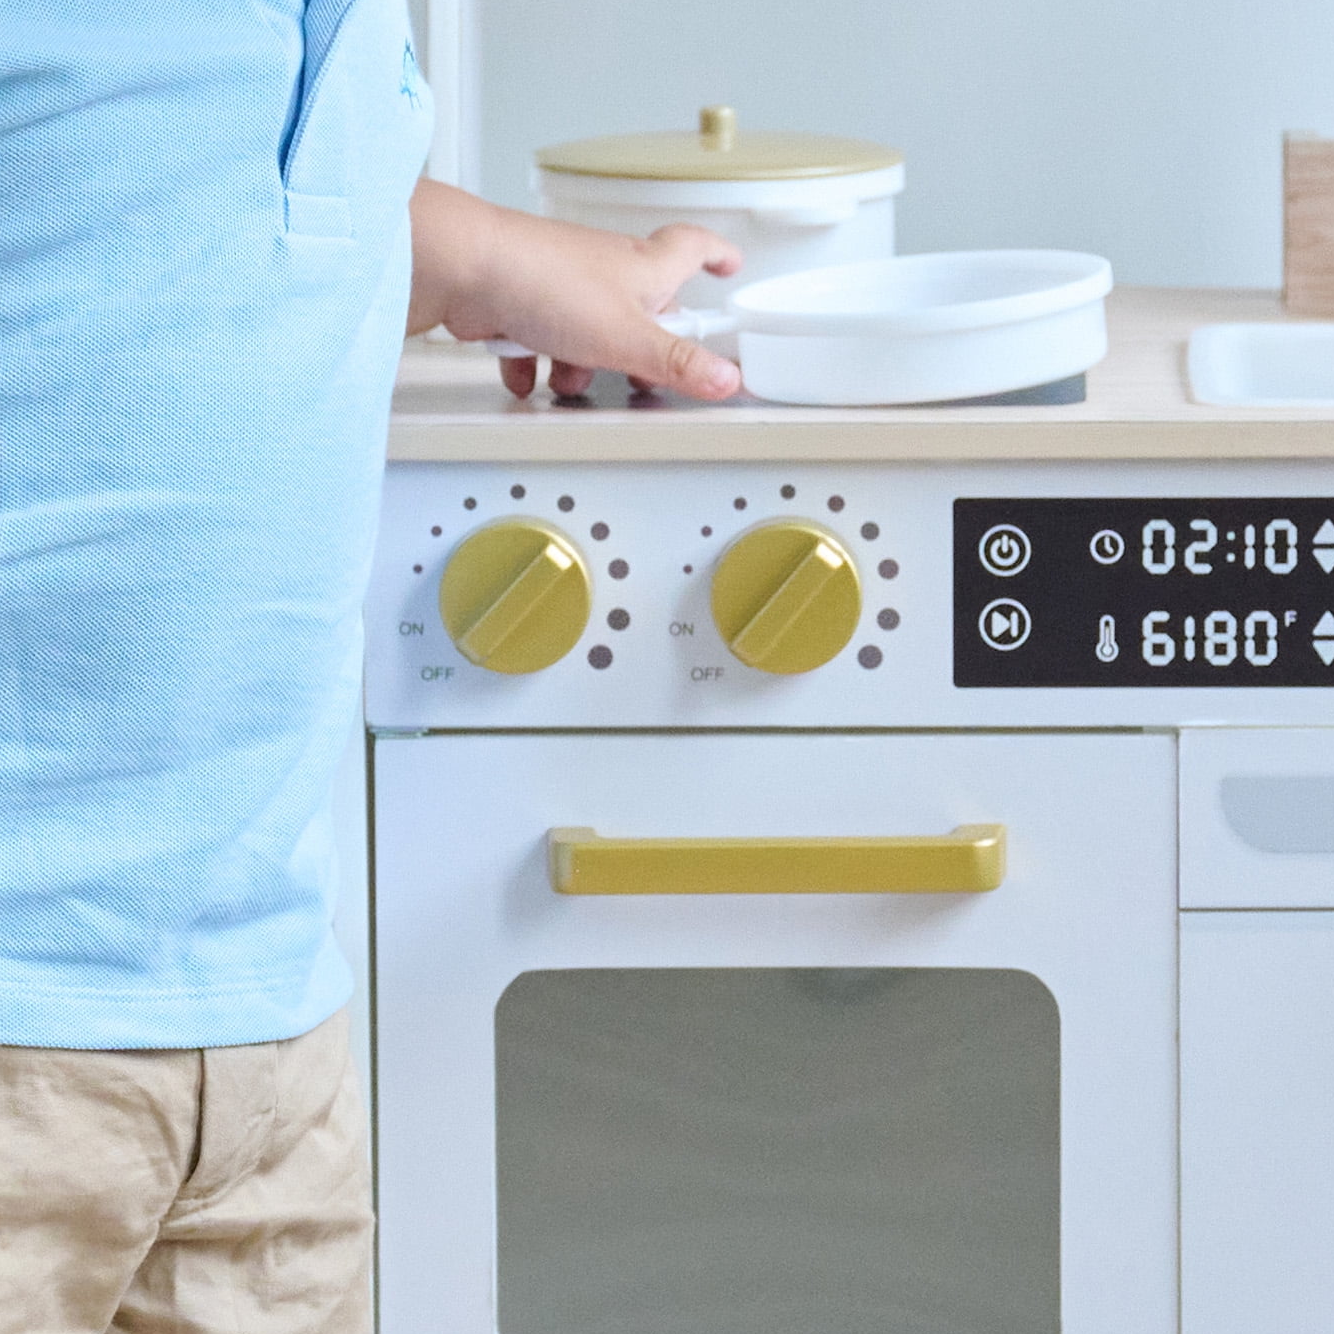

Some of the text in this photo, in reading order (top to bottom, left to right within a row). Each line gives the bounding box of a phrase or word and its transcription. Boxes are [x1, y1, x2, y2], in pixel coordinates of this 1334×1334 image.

[1141, 518, 1299, 575] 02:10
[398, 620, 425, 637] ON
[668, 620, 696, 638] ON
[420, 665, 456, 682] OFF
[690, 665, 726, 683] OFF
